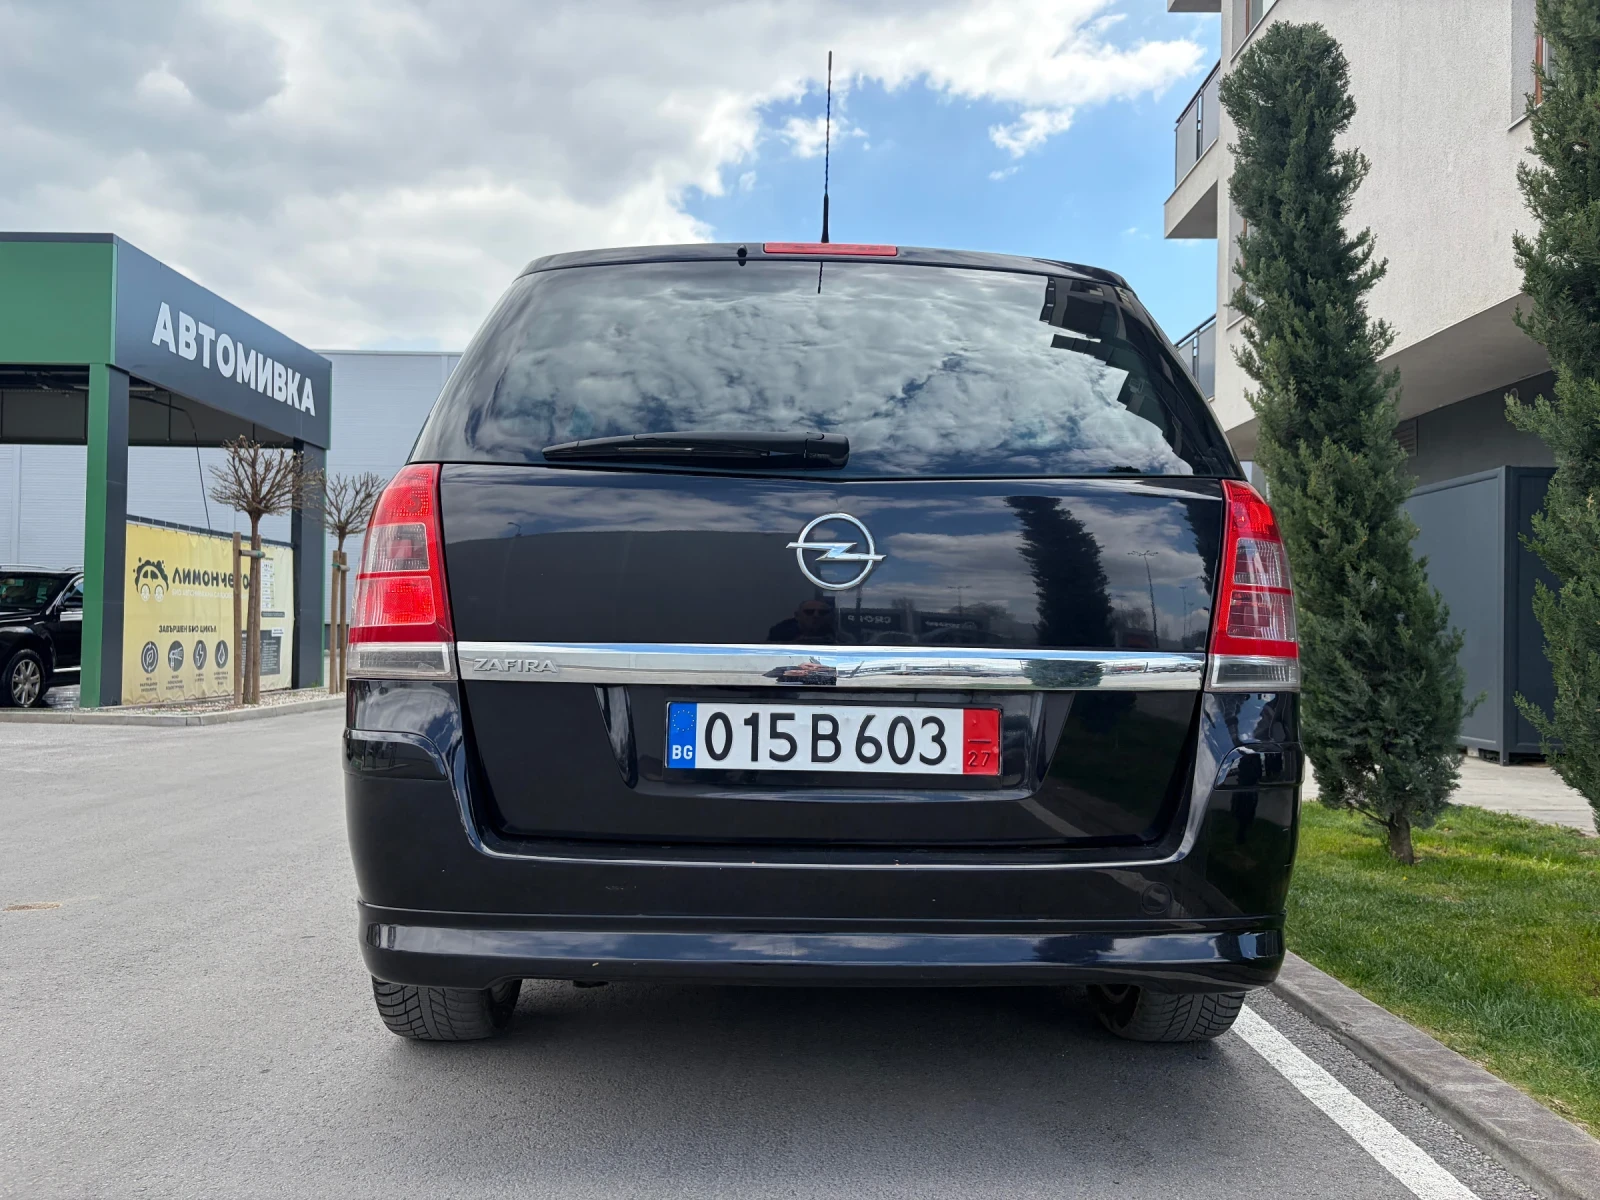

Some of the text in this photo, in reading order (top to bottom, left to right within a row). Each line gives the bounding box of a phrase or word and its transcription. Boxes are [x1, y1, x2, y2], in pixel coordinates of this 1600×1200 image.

[151, 301, 316, 417] АВТОМИВКА
[158, 625, 188, 634] ЗАВЪРШЕН
[188, 625, 199, 633] БИО
[473, 658, 559, 673] ZAFIRA
[672, 745, 693, 760] BG
[967, 750, 991, 768] 27
